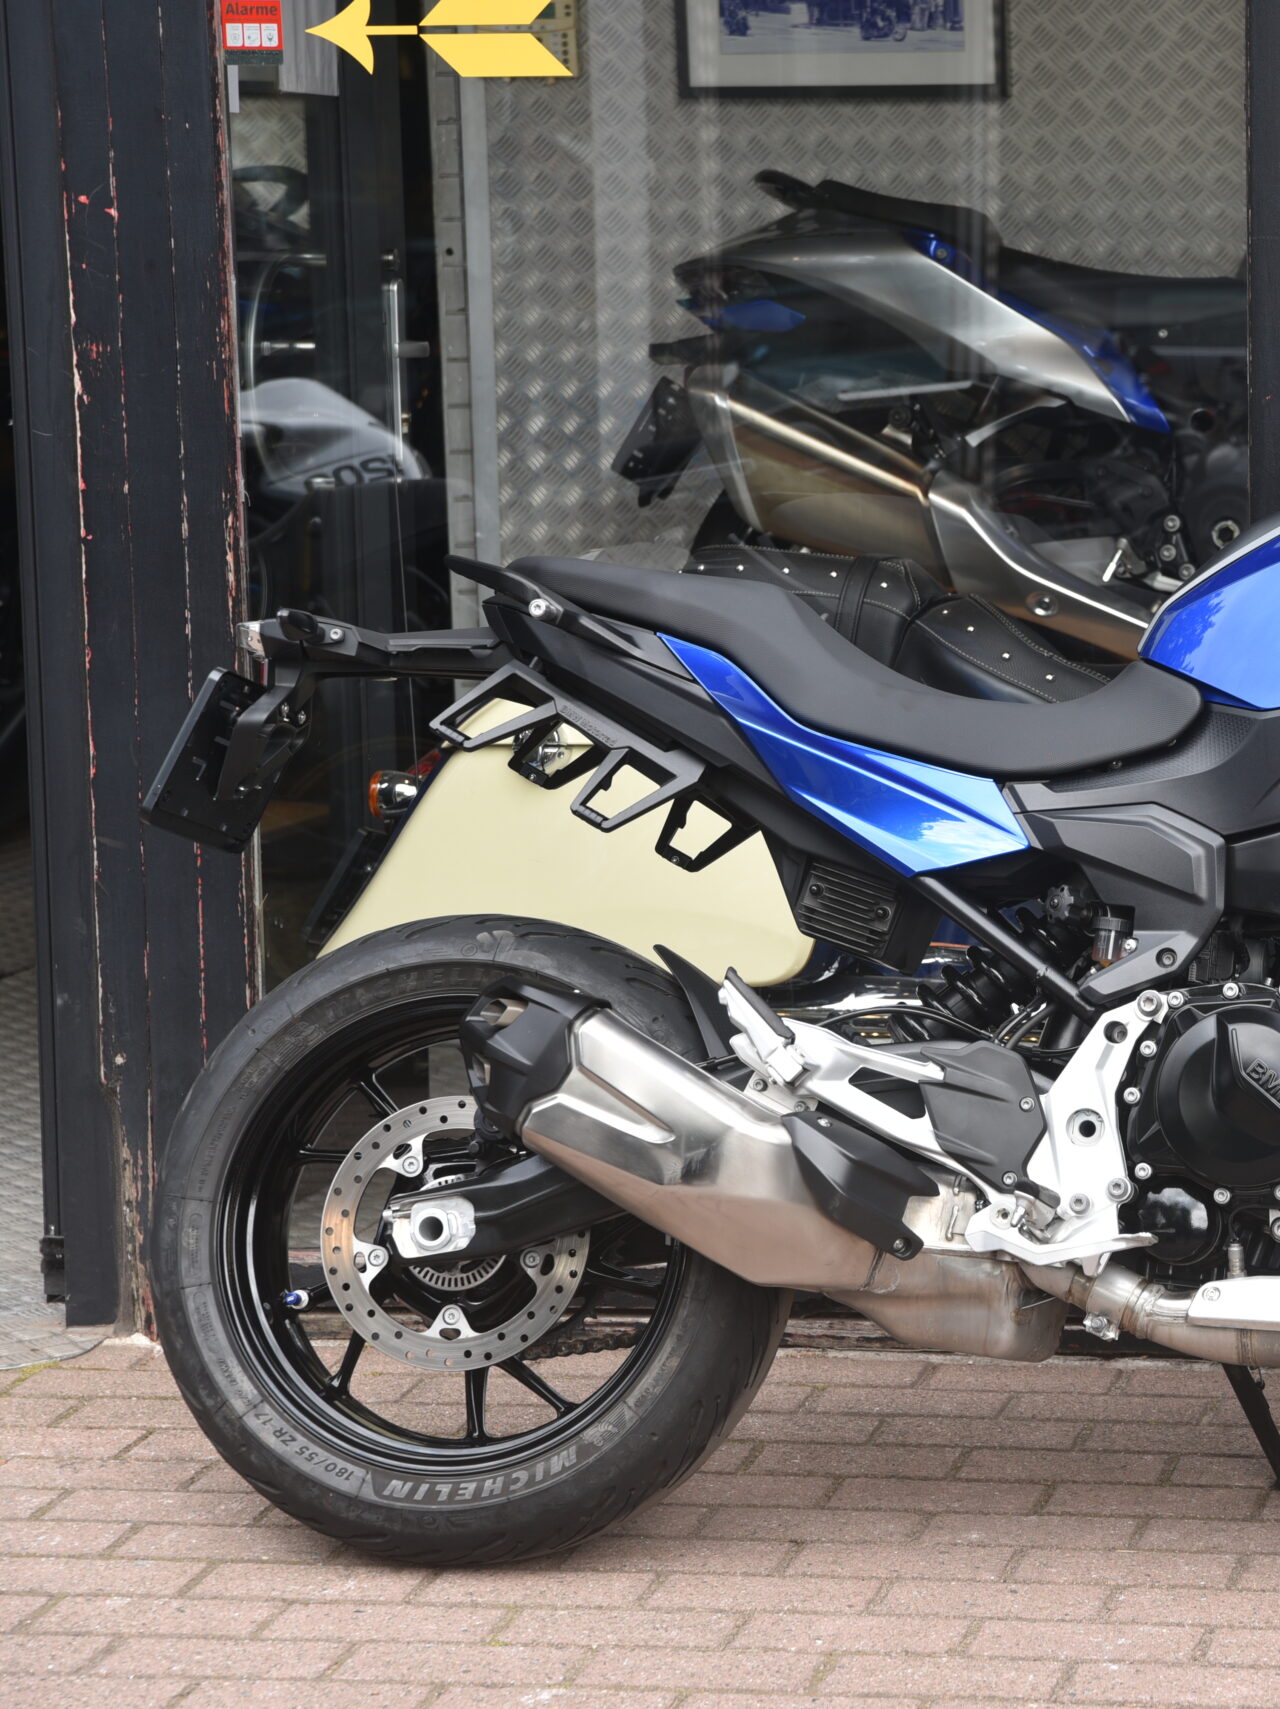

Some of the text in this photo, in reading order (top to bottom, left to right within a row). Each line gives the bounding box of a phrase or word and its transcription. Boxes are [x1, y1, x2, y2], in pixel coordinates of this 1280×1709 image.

[225, 2, 278, 16] Alarme
[254, 1411, 274, 1426] 17
[272, 1426, 298, 1447] ZR
[294, 1445, 355, 1482] 180/55
[382, 1445, 577, 1501] MICHELIN
